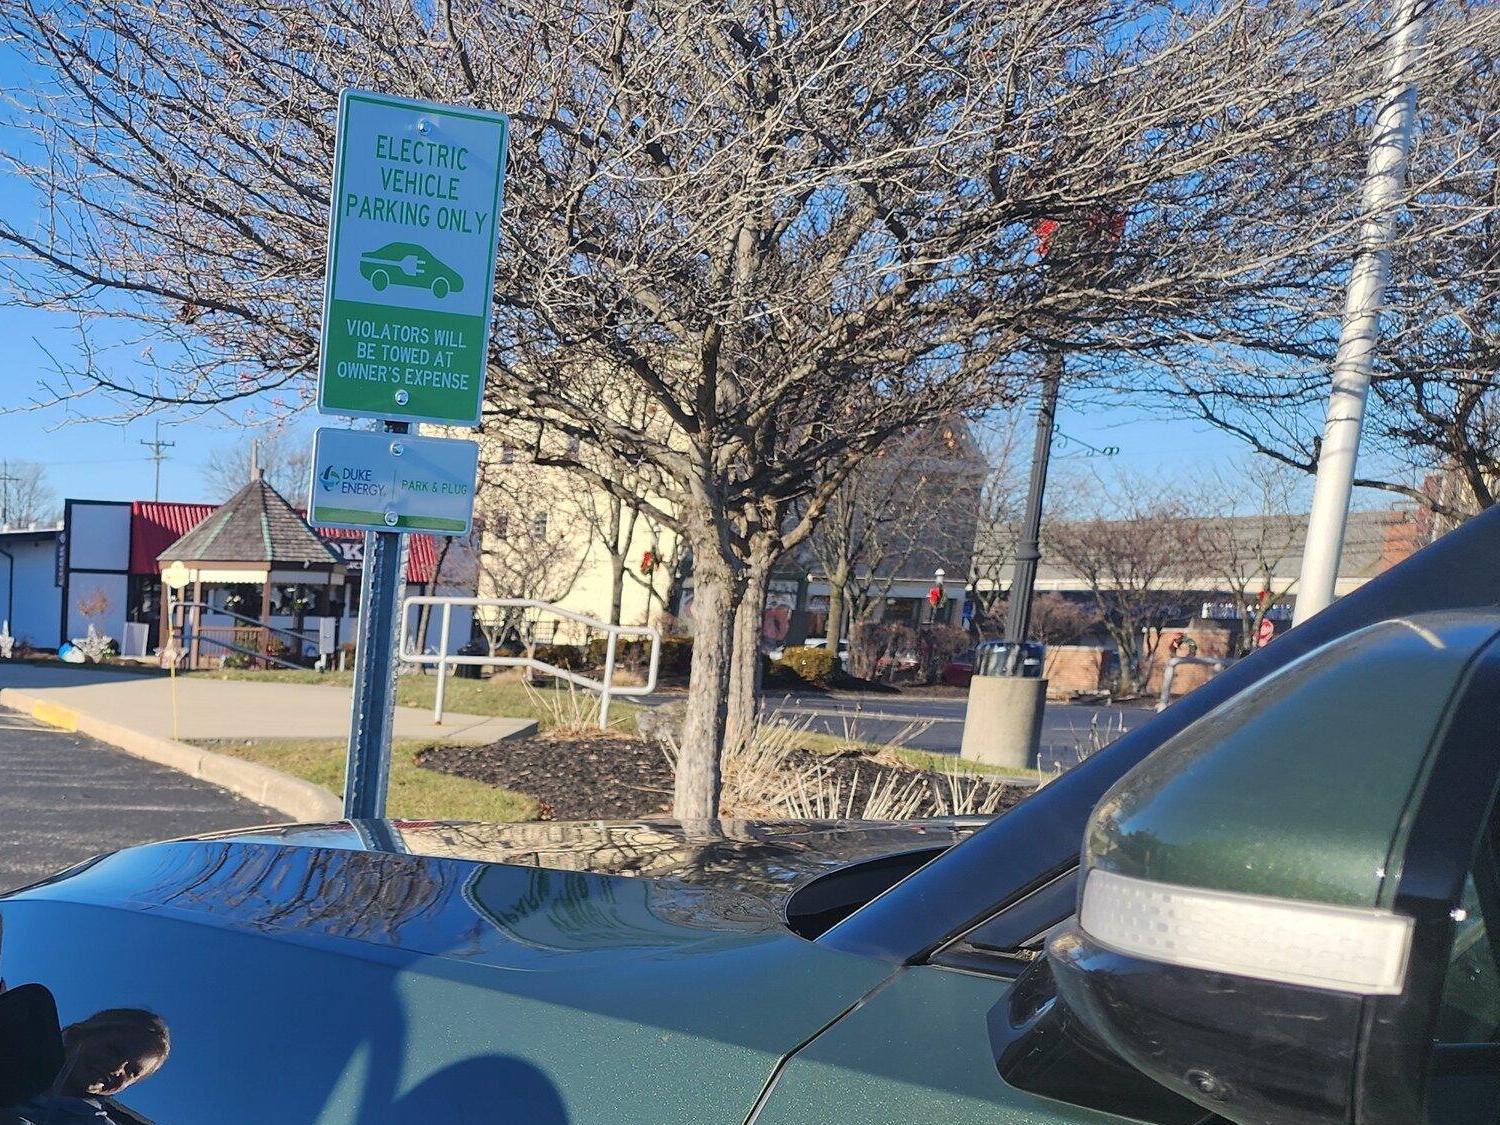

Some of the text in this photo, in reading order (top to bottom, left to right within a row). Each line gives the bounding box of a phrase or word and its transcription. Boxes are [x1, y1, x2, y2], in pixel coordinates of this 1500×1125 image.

[376, 134, 469, 171] ELECTRIC
[381, 166, 460, 201] VEHICLE
[346, 193, 488, 235] PARKING ONLY
[346, 318, 467, 349] VIOLATORS WILL
[357, 341, 454, 368] BE TOWED AT
[337, 361, 470, 391] OWNER'S EXPENSE
[343, 467, 373, 481] DUKE
[401, 479, 468, 495] PARK & PLUG
